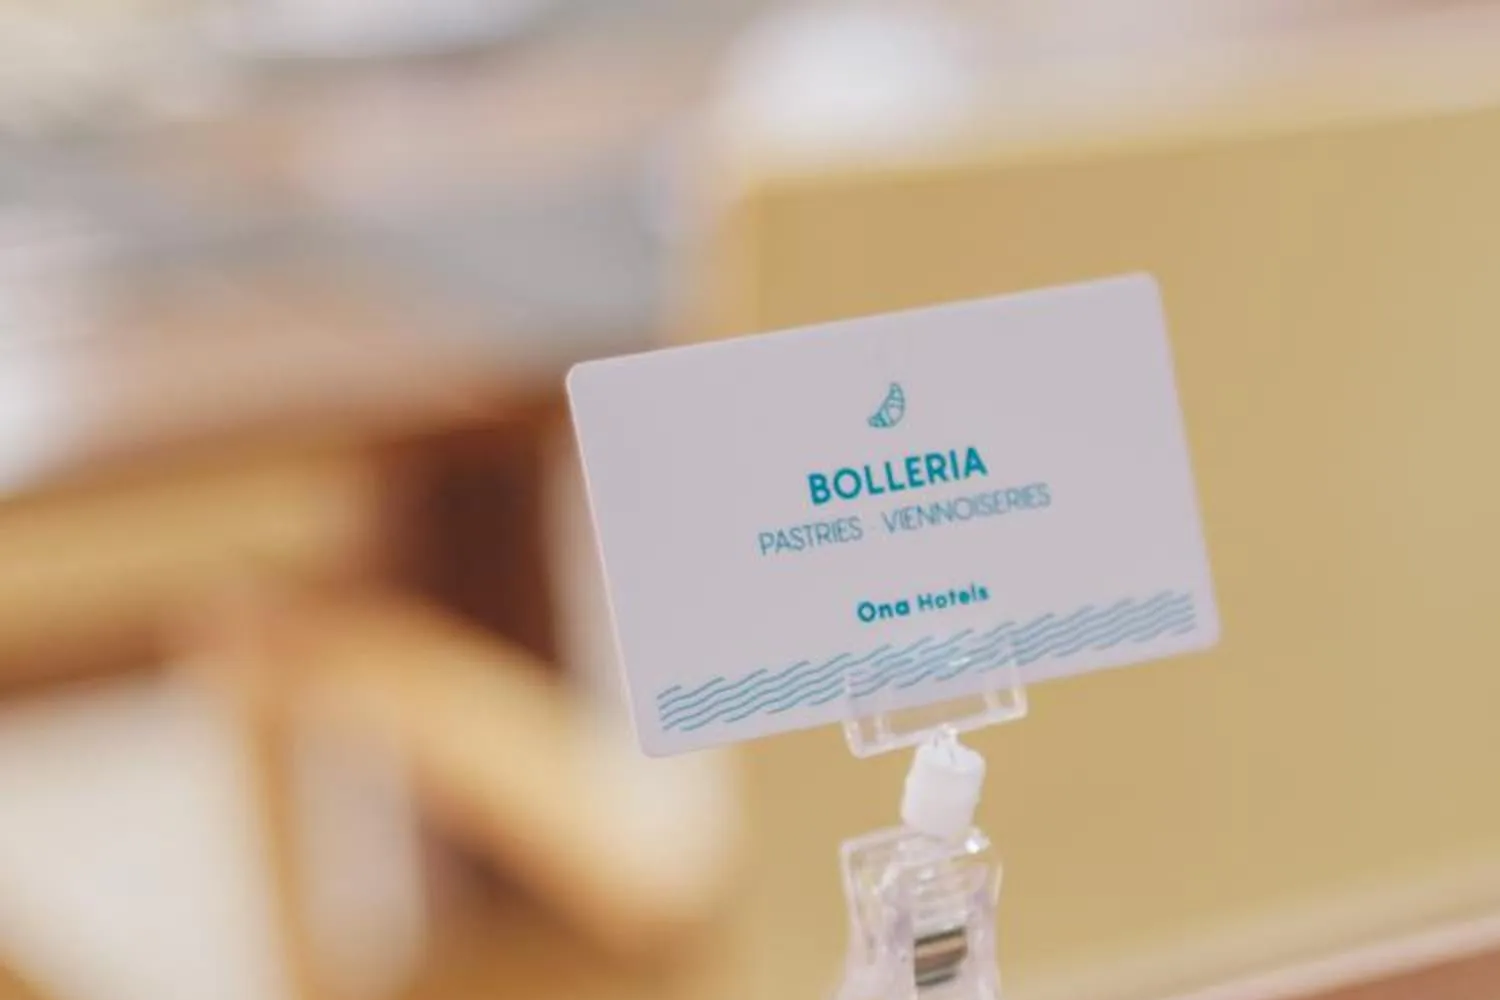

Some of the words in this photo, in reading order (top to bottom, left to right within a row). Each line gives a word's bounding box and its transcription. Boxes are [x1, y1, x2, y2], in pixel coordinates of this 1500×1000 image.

[806, 446, 988, 506] BOLLERIA
[758, 516, 863, 556] PASTRIES
[882, 482, 1051, 534] VIENNOISERIES
[856, 599, 911, 625] Ona
[916, 583, 990, 612] Hotels
